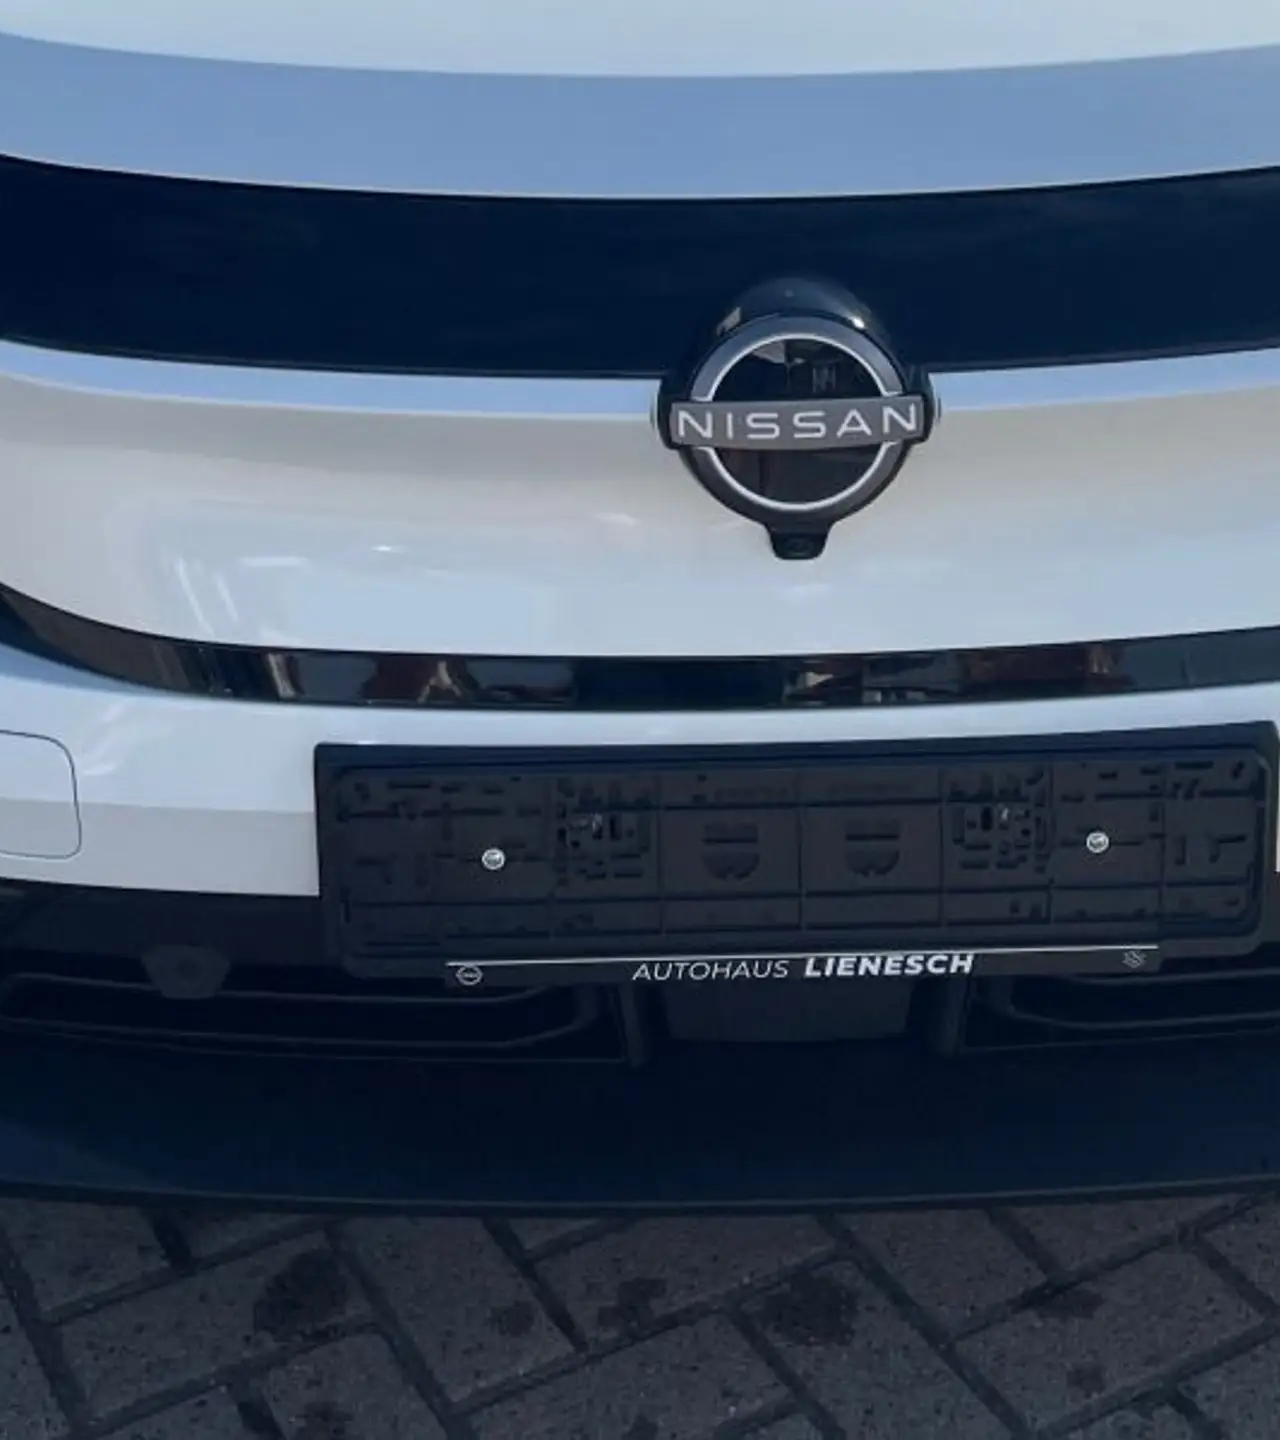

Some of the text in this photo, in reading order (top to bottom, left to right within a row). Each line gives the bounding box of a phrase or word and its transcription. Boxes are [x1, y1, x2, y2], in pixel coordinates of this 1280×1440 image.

[677, 403, 917, 440] NISSAN
[632, 953, 975, 981] AUTOHAUS LIENESCH
